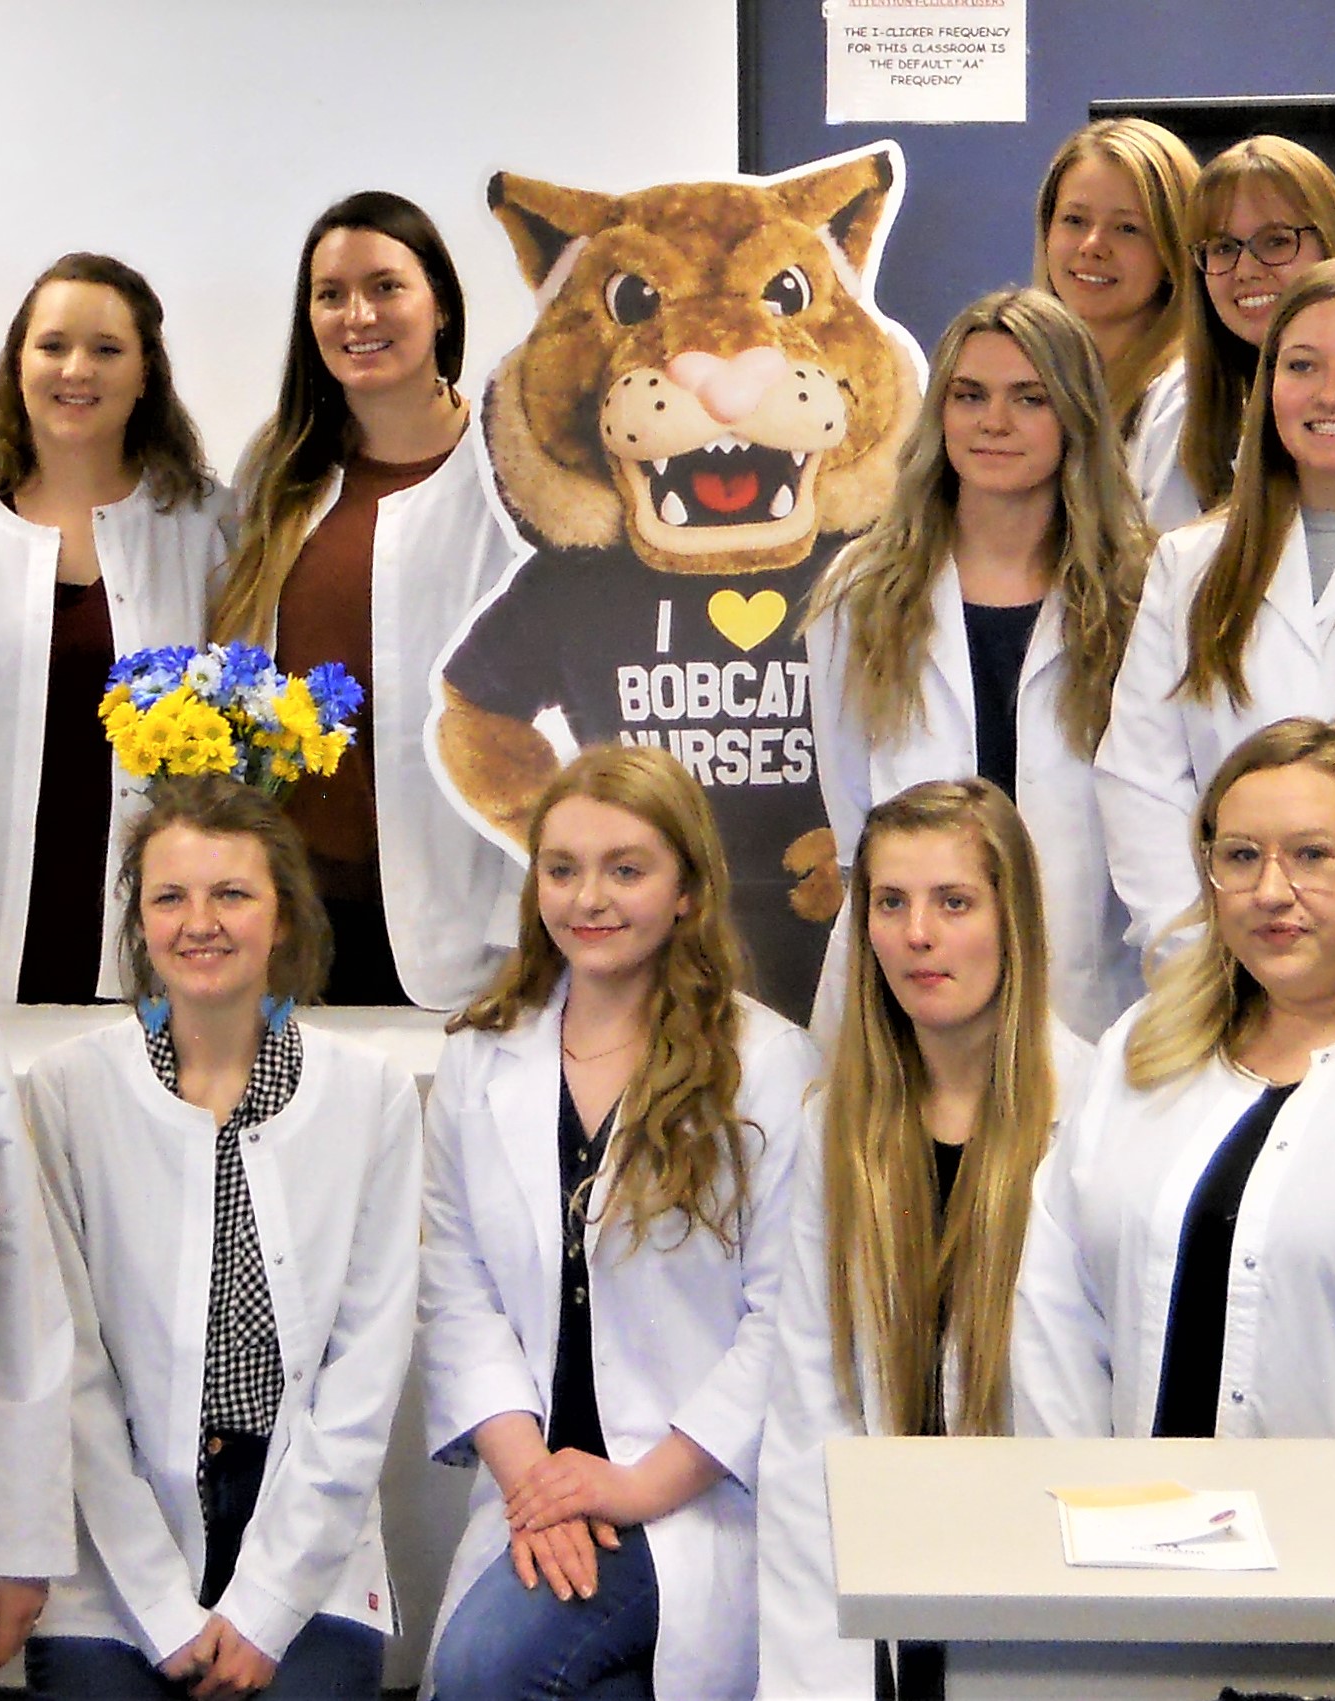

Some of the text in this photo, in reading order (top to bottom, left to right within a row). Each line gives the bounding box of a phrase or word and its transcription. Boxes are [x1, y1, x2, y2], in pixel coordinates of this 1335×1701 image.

[844, 26, 1010, 39] THE I-CLICKER FREQUENCY
[847, 43, 1006, 53] FOR THIS CLASSROOM IS
[870, 59, 893, 69] THE
[898, 59, 953, 69] DEFAULT
[890, 75, 962, 87] FREQUENCY
[656, 599, 672, 653] I
[617, 660, 811, 722] BOBCAT
